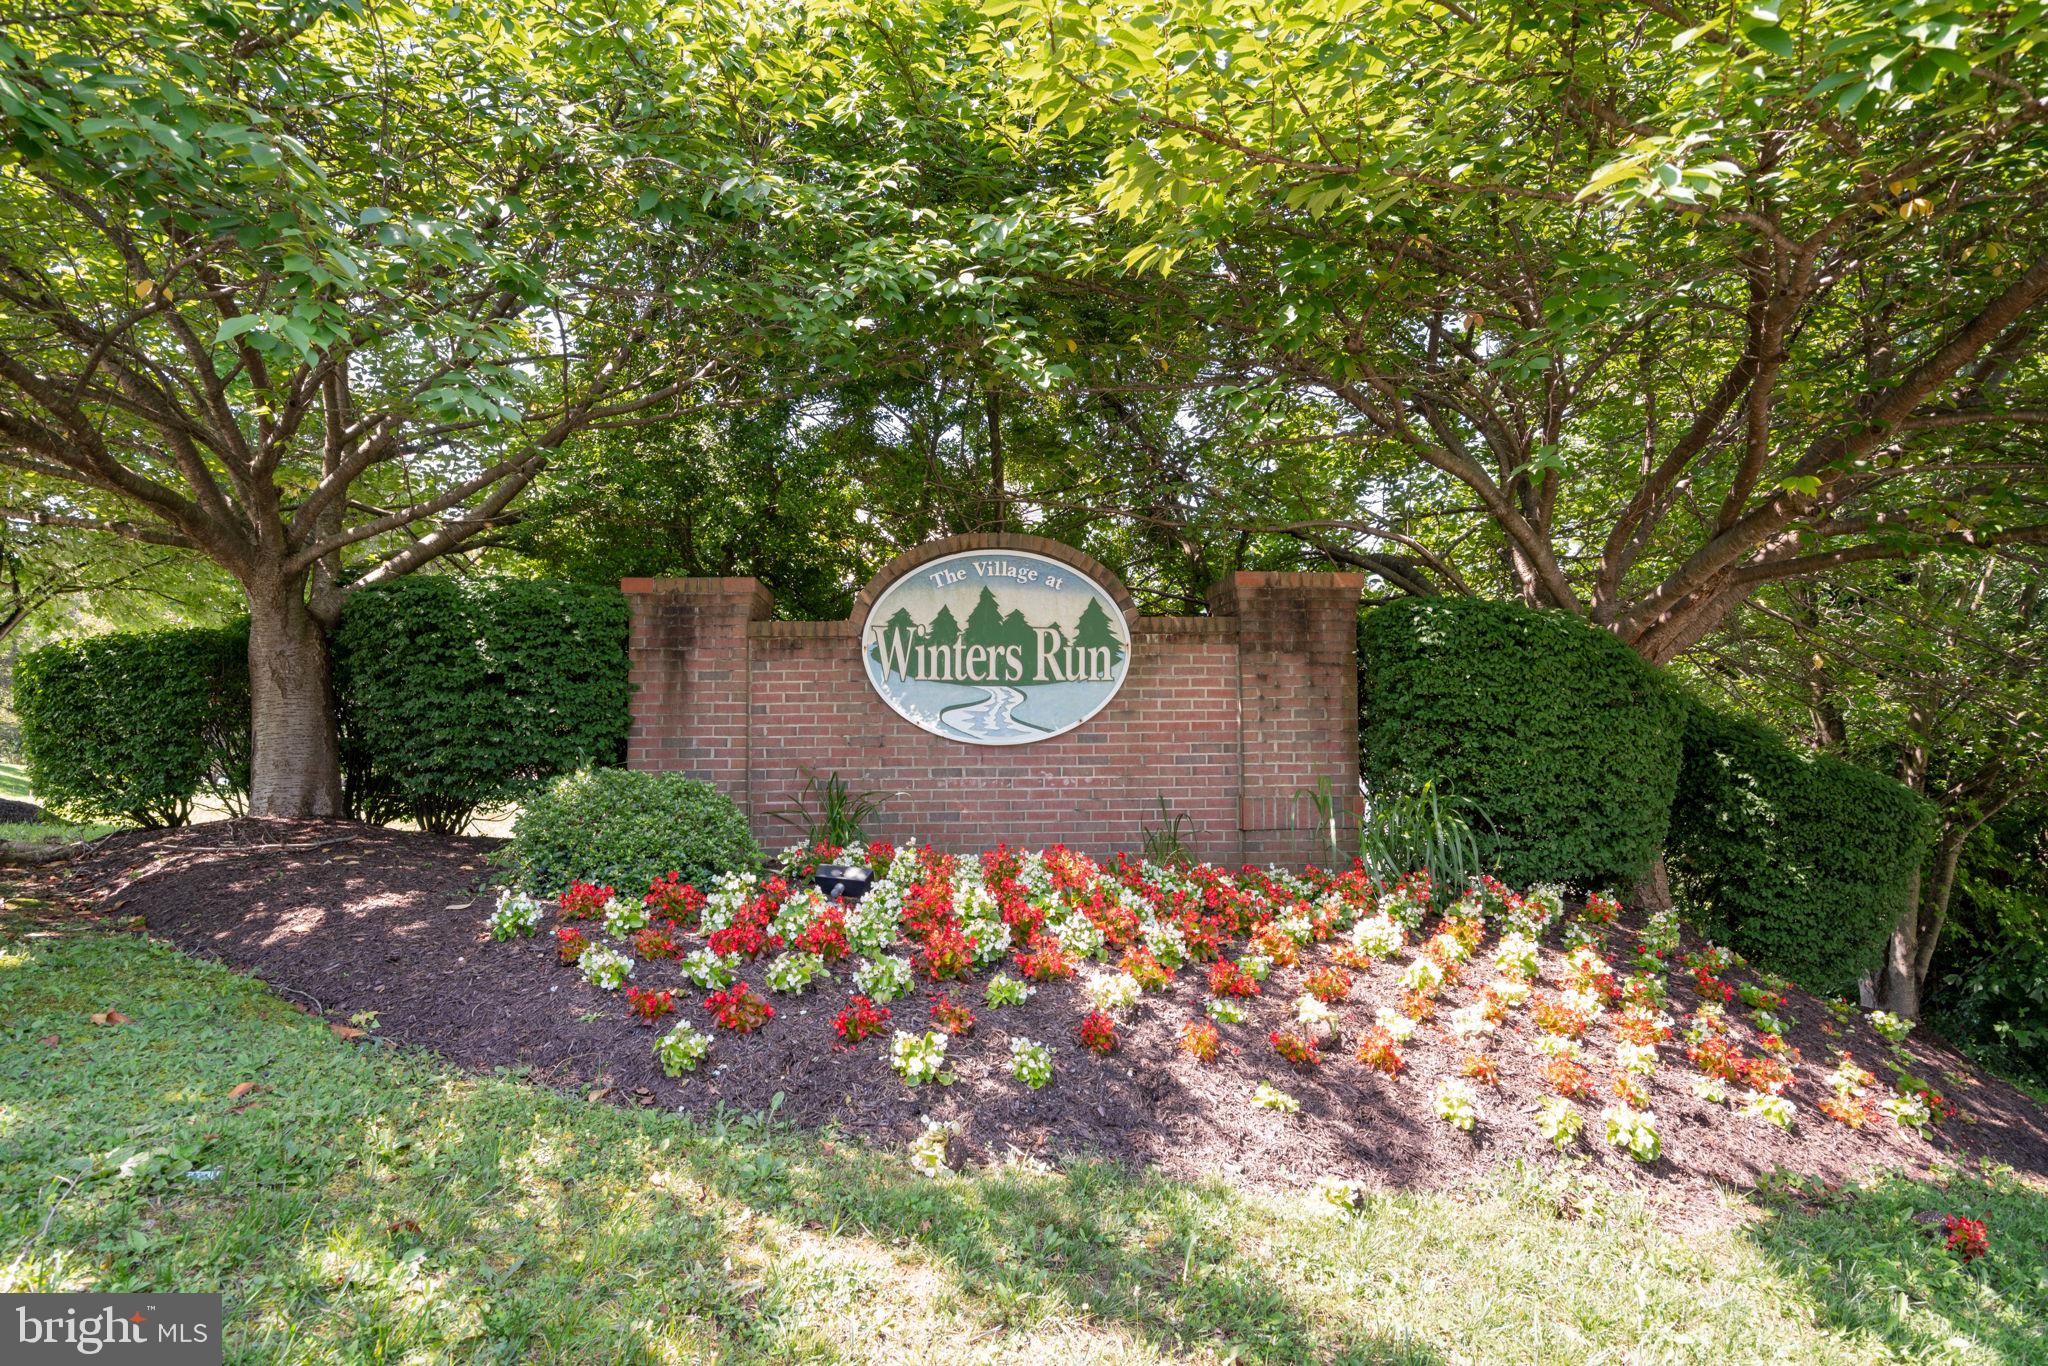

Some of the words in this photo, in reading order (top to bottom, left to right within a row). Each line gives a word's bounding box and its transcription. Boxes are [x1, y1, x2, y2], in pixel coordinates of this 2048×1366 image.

[929, 568, 967, 590] The
[972, 560, 1038, 583] Village
[1045, 573, 1063, 591] at
[871, 624, 1024, 684] Winters
[1032, 627, 1115, 684] Run
